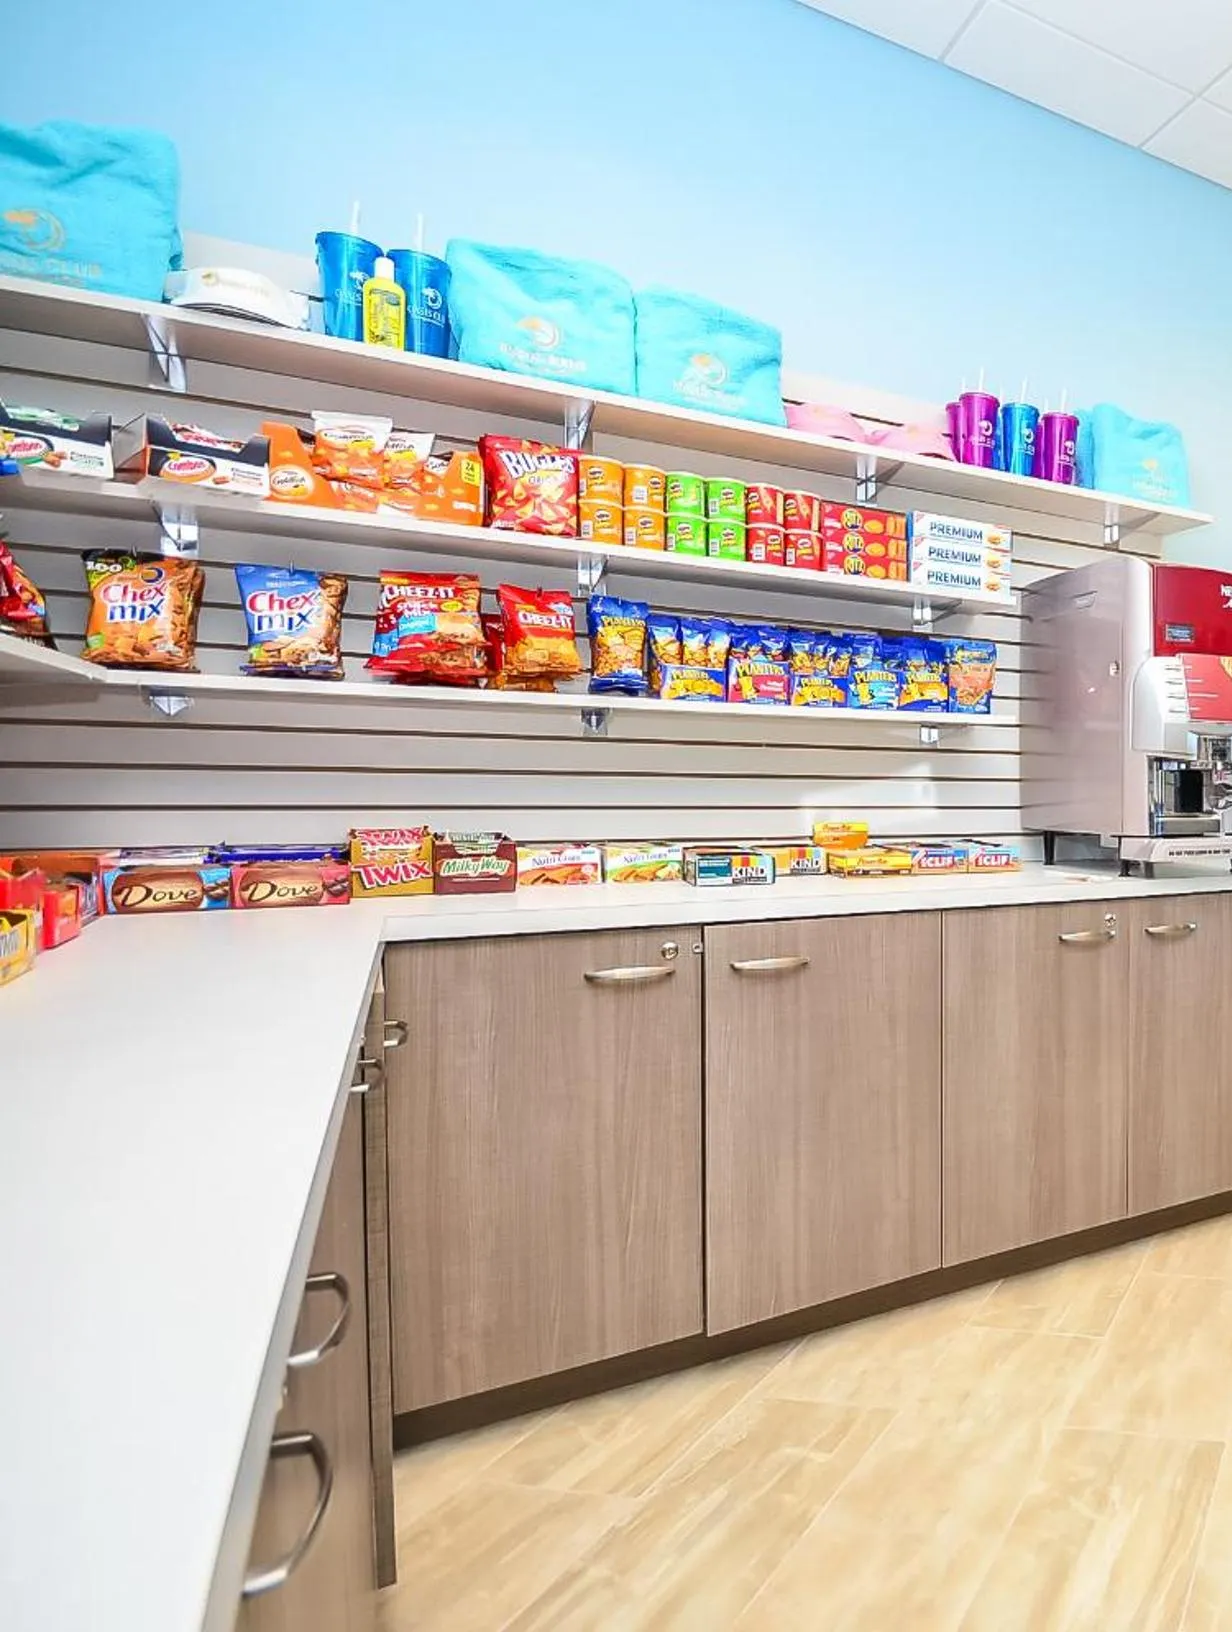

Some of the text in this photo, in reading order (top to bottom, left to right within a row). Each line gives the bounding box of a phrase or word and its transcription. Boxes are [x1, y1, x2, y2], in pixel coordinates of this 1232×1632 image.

[929, 521, 983, 540] PREMIUM
[928, 546, 981, 563] PREMIUM
[927, 570, 981, 587] PREMIUM
[102, 583, 167, 603] Chex
[247, 589, 318, 613] Chex
[108, 598, 164, 622] mix
[256, 607, 315, 632] mix
[442, 856, 510, 876] Milky Way
[733, 866, 766, 877] KIND
[792, 858, 820, 869] KIND
